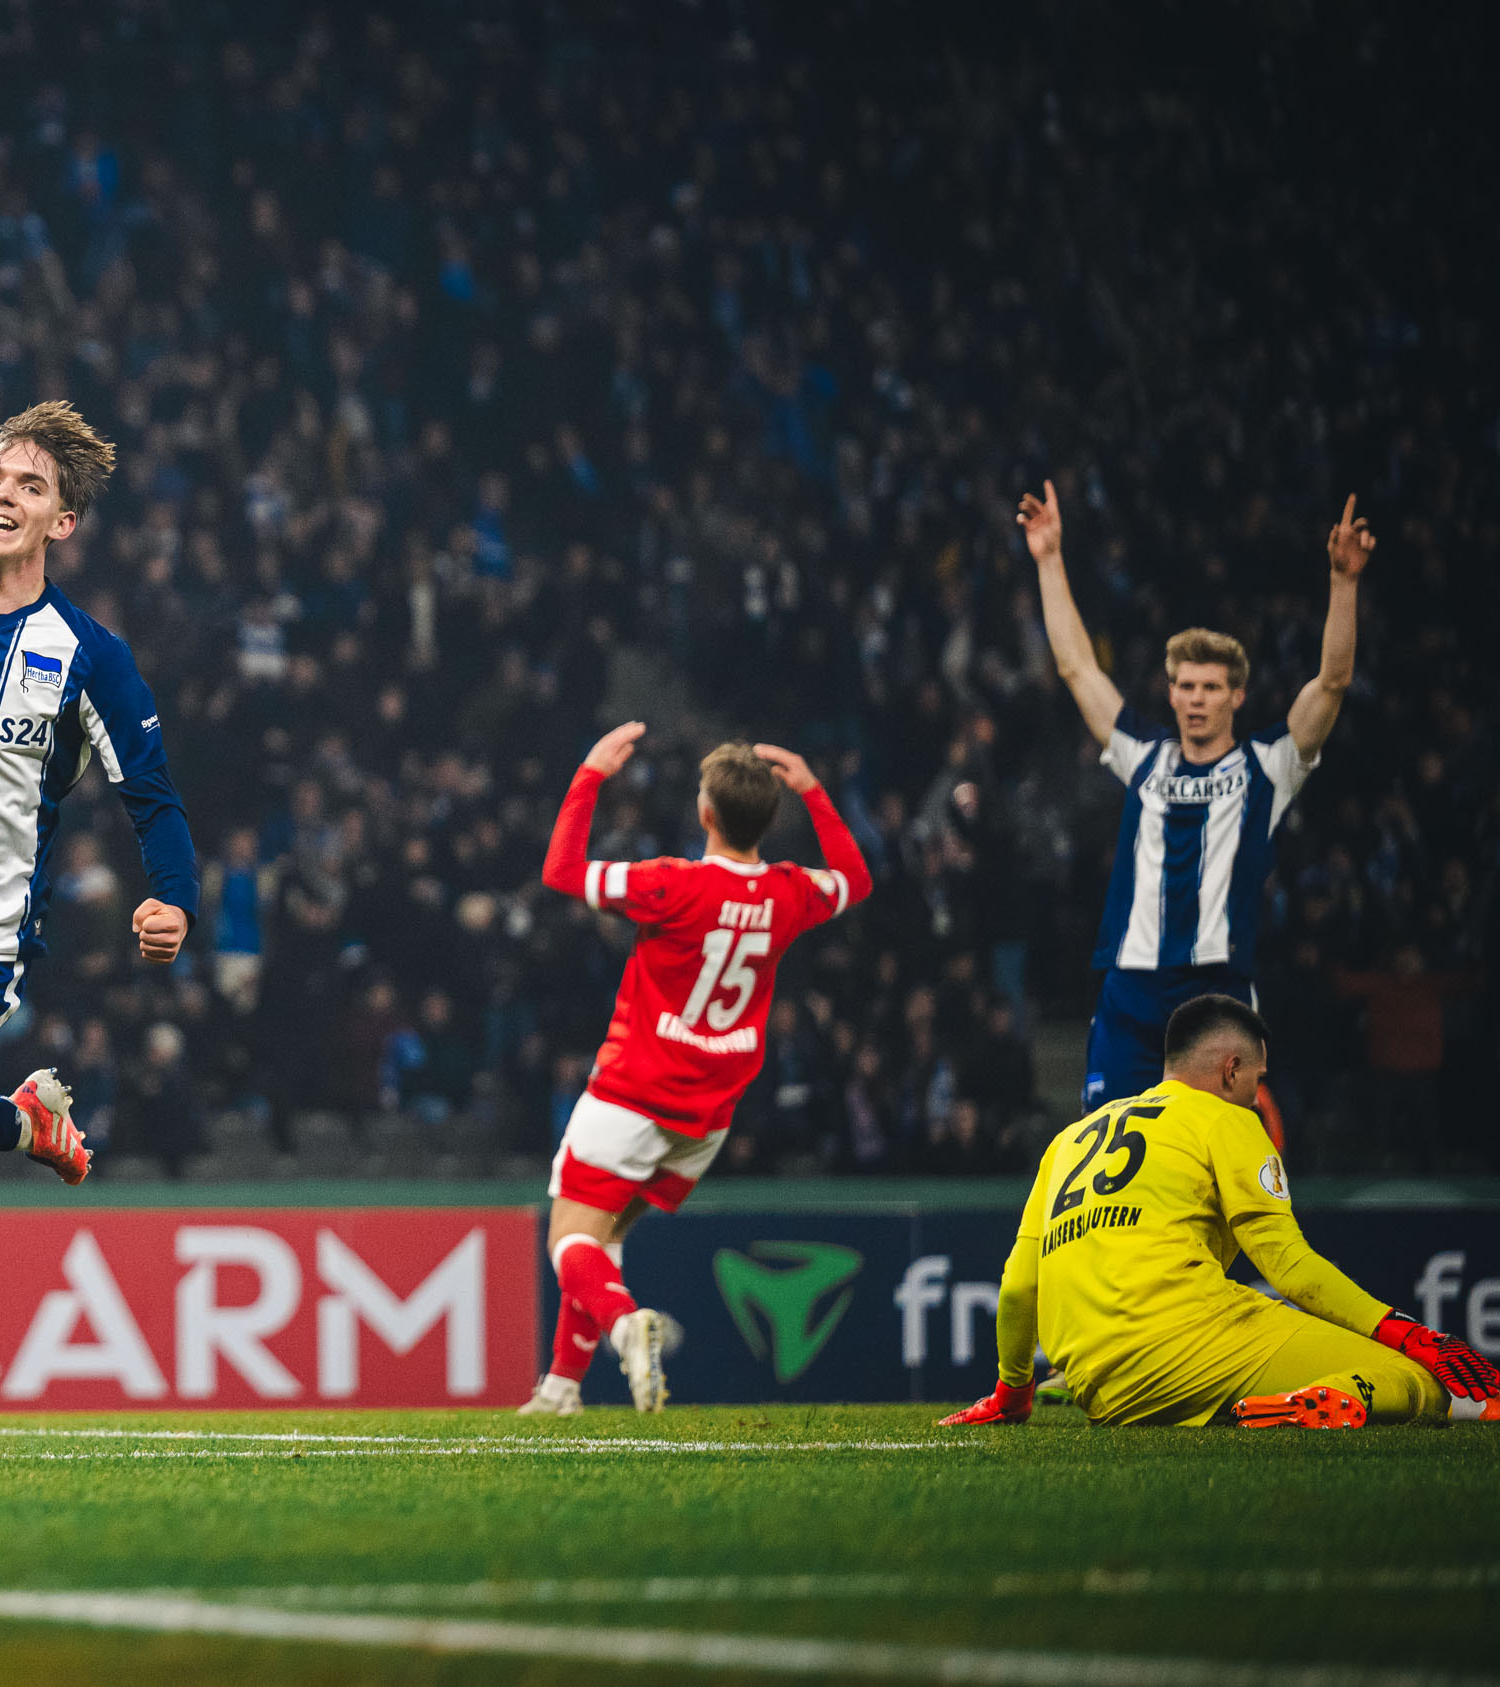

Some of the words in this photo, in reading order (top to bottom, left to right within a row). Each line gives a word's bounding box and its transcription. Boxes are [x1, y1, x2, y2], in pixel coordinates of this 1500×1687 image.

[27, 668, 48, 682] Hertha
[48, 672, 60, 685] BSC
[681, 927, 773, 1032] 15
[1050, 1105, 1167, 1221] 25
[1041, 1205, 1143, 1259] KAISERSLAUTERN
